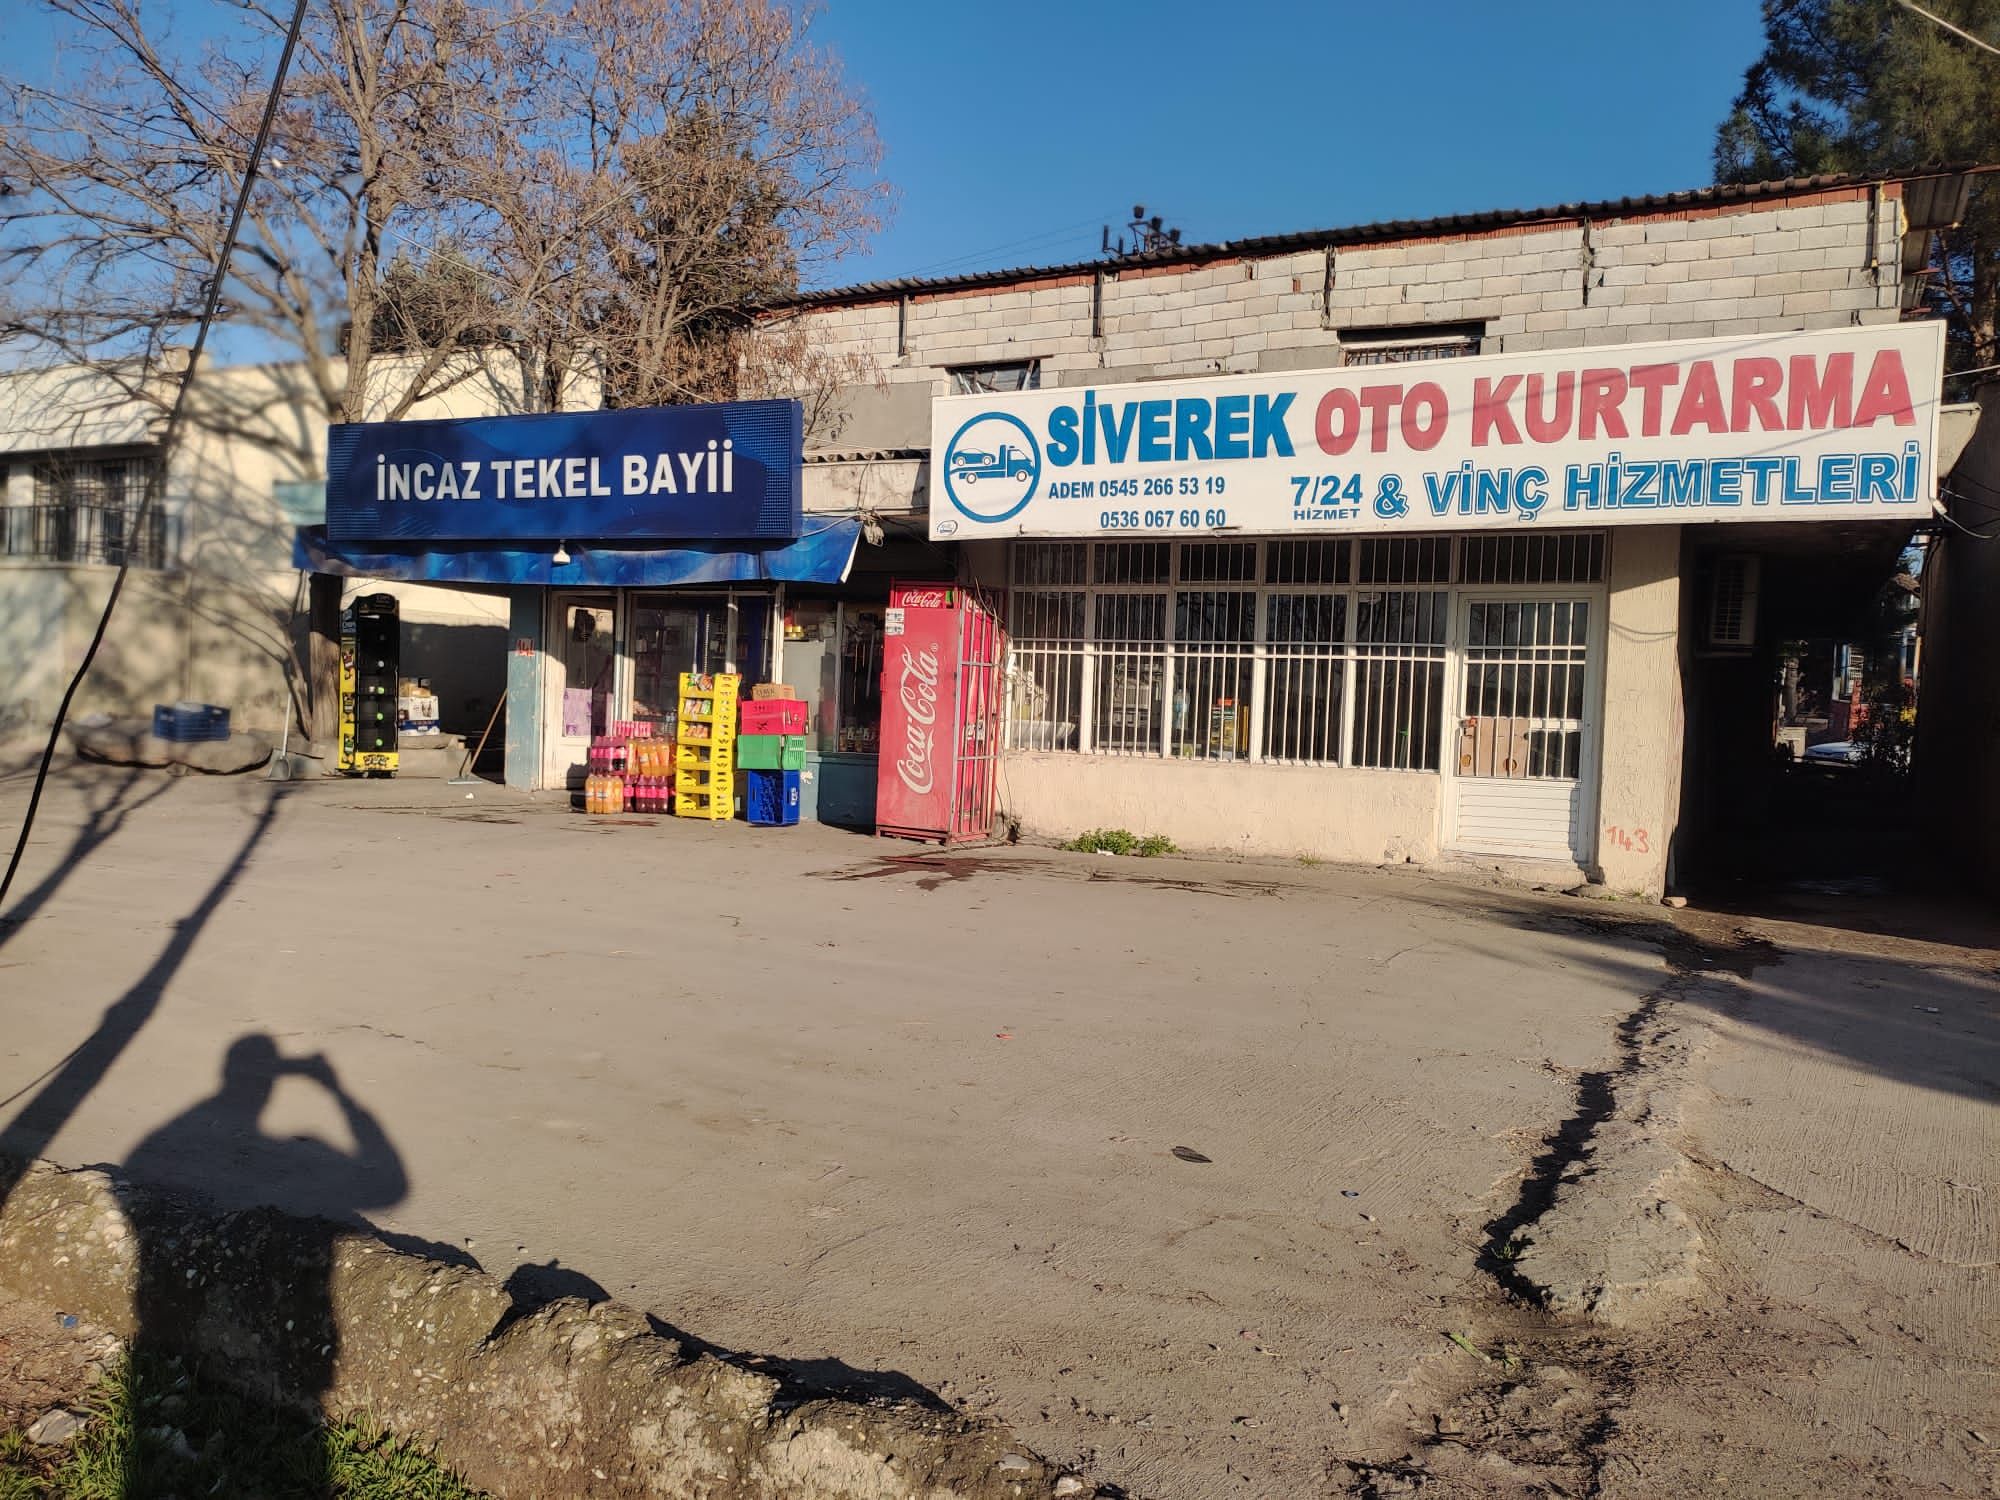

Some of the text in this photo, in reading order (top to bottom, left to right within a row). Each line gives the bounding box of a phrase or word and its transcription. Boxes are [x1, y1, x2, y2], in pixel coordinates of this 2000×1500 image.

[1046, 349, 1917, 467] SİVEREK OTO KURTARMA
[377, 454, 481, 501] İNCAZ
[491, 457, 612, 499] TEKEL
[1048, 476, 1226, 499] ADEM 0545 266 53 19
[1290, 439, 1922, 521] 7/24 & VİNÇ HİZMETLERİ
[1100, 509, 1226, 528] 0536 067 60 60
[1292, 507, 1360, 521] HİZMET
[896, 645, 938, 795] Coca-Cola
[1606, 826, 1650, 854] 143
